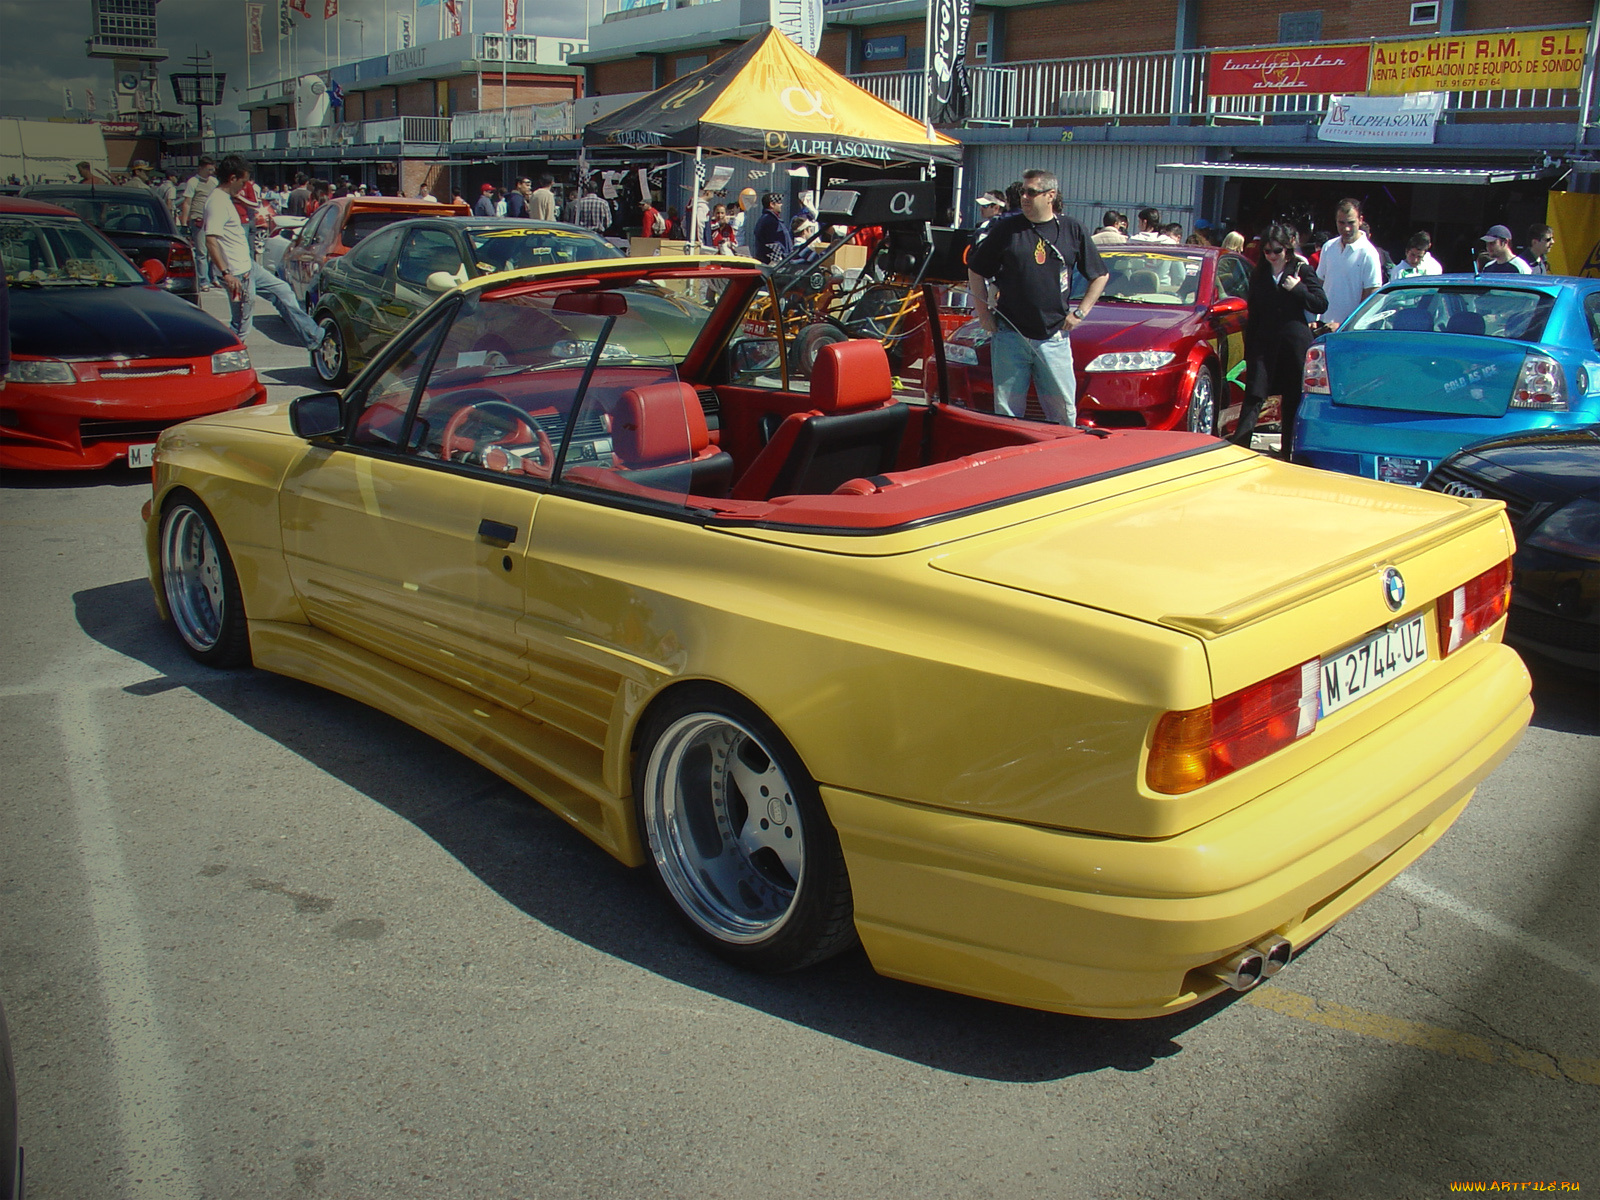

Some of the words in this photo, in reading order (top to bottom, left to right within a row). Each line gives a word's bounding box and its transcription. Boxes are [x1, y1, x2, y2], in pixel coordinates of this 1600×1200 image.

[1475, 38, 1521, 58] R.M.
[1541, 35, 1583, 56] S.L.
[1401, 67, 1406, 79] E
[1408, 63, 1465, 78] INSTALACION
[1467, 62, 1480, 75] DE
[1482, 60, 1522, 76] EQUIPOS
[1526, 60, 1539, 73] DE
[1542, 58, 1582, 73] SONIDO
[1451, 79, 1460, 87] 91
[1490, 78, 1500, 86] 64
[1061, 131, 1073, 141] 29
[789, 139, 893, 160] ALPHASONIK
[1443, 376, 1467, 393] COLD
[1468, 370, 1481, 384] AS
[1481, 364, 1498, 378] ICE
[131, 448, 141, 465] M
[1325, 661, 1340, 706] M
[1345, 634, 1396, 696] 2744
[1400, 618, 1425, 663] UZ
